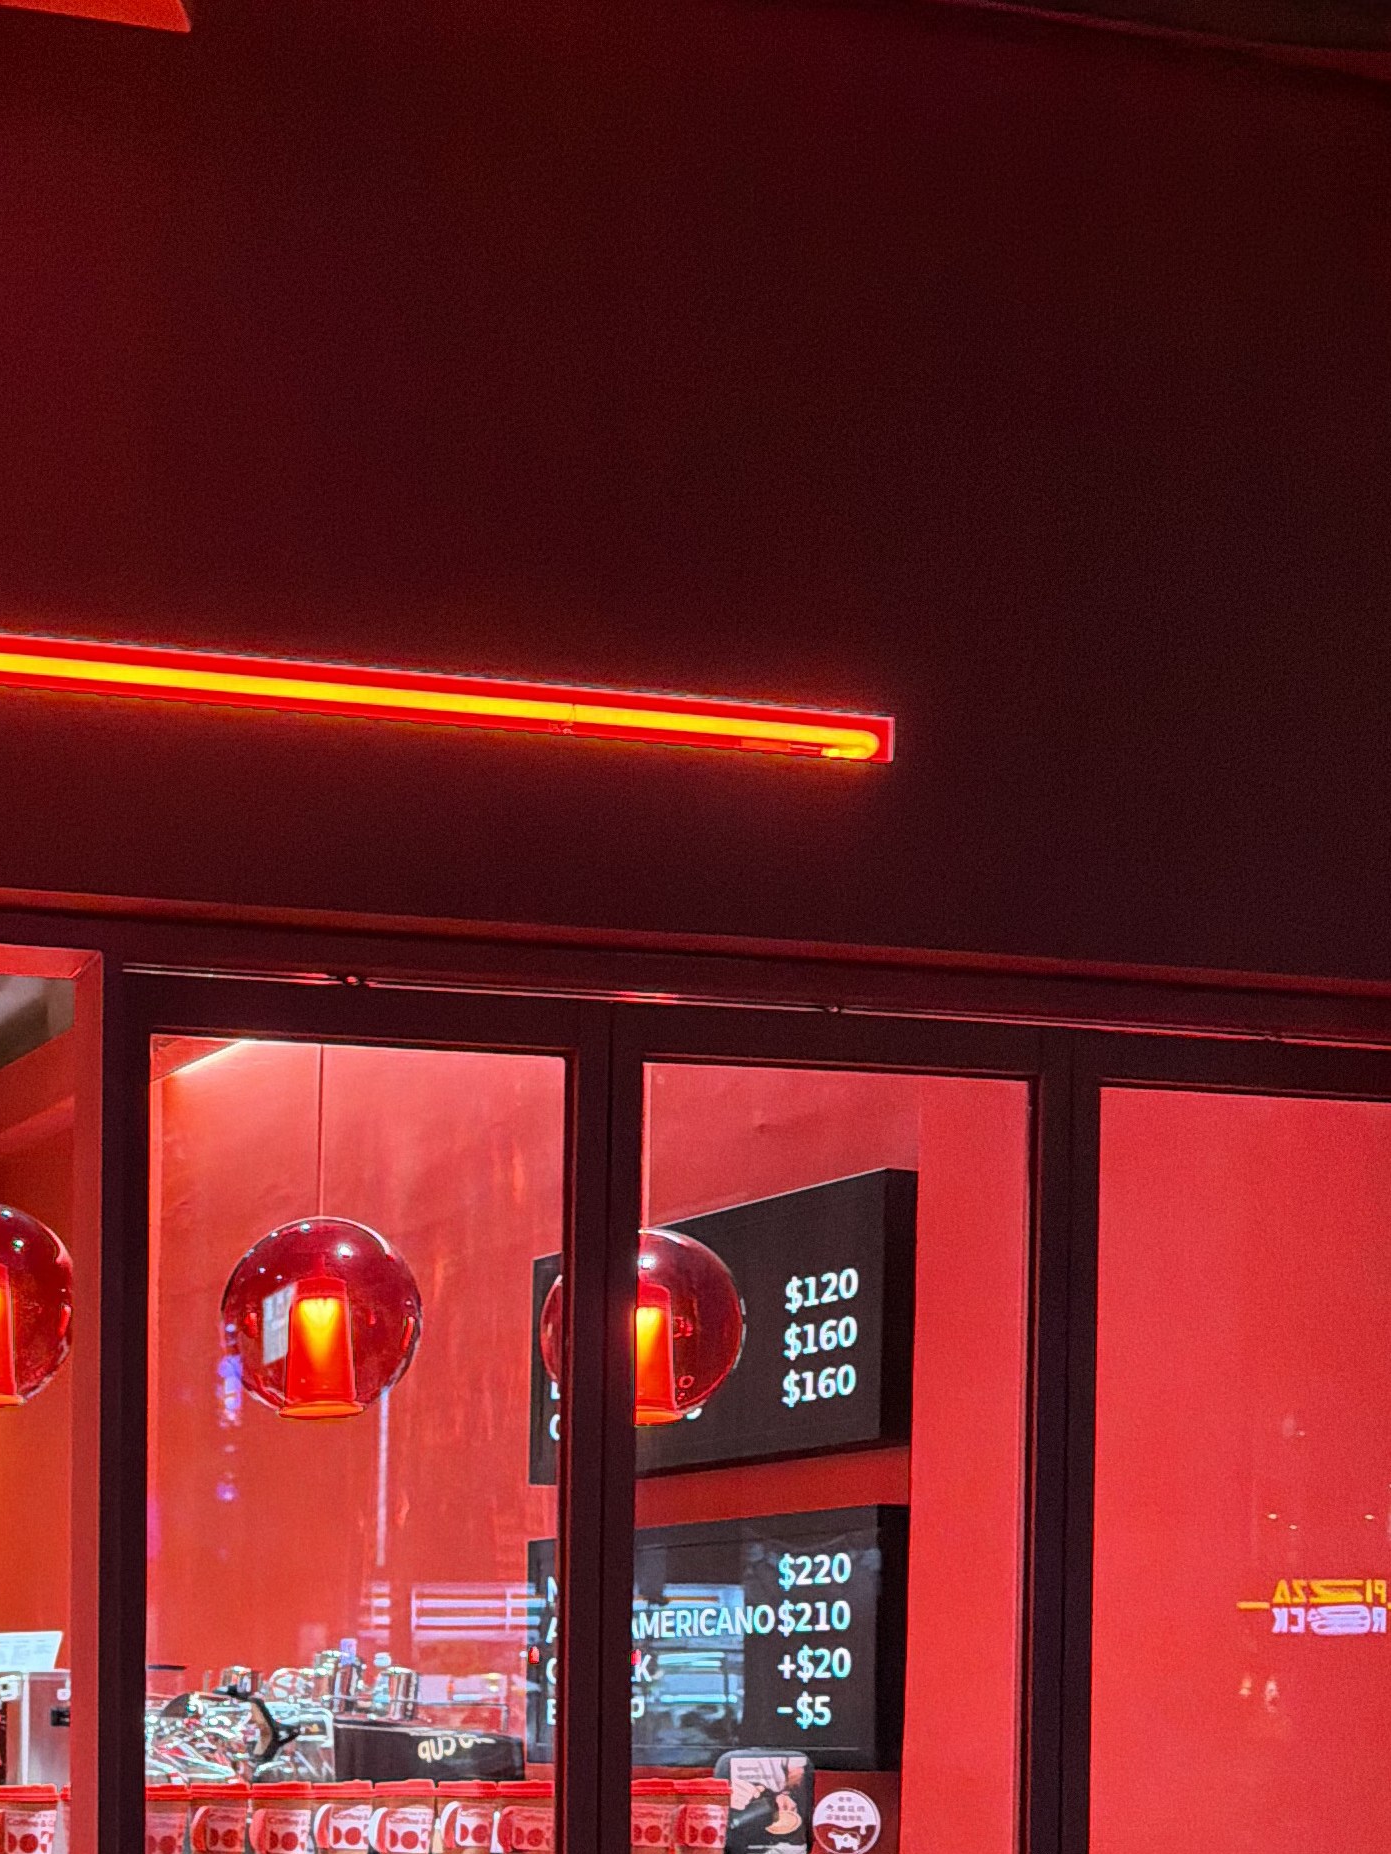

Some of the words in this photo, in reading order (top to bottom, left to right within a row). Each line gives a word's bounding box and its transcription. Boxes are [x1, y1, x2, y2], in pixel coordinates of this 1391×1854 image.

[785, 1268, 858, 1313] $120
[783, 1316, 858, 1361] $160
[782, 1364, 857, 1408] $160
[777, 1552, 851, 1591] $220
[777, 1600, 851, 1637] $210
[777, 1644, 851, 1684] +$20
[777, 1691, 832, 1730] -$5
